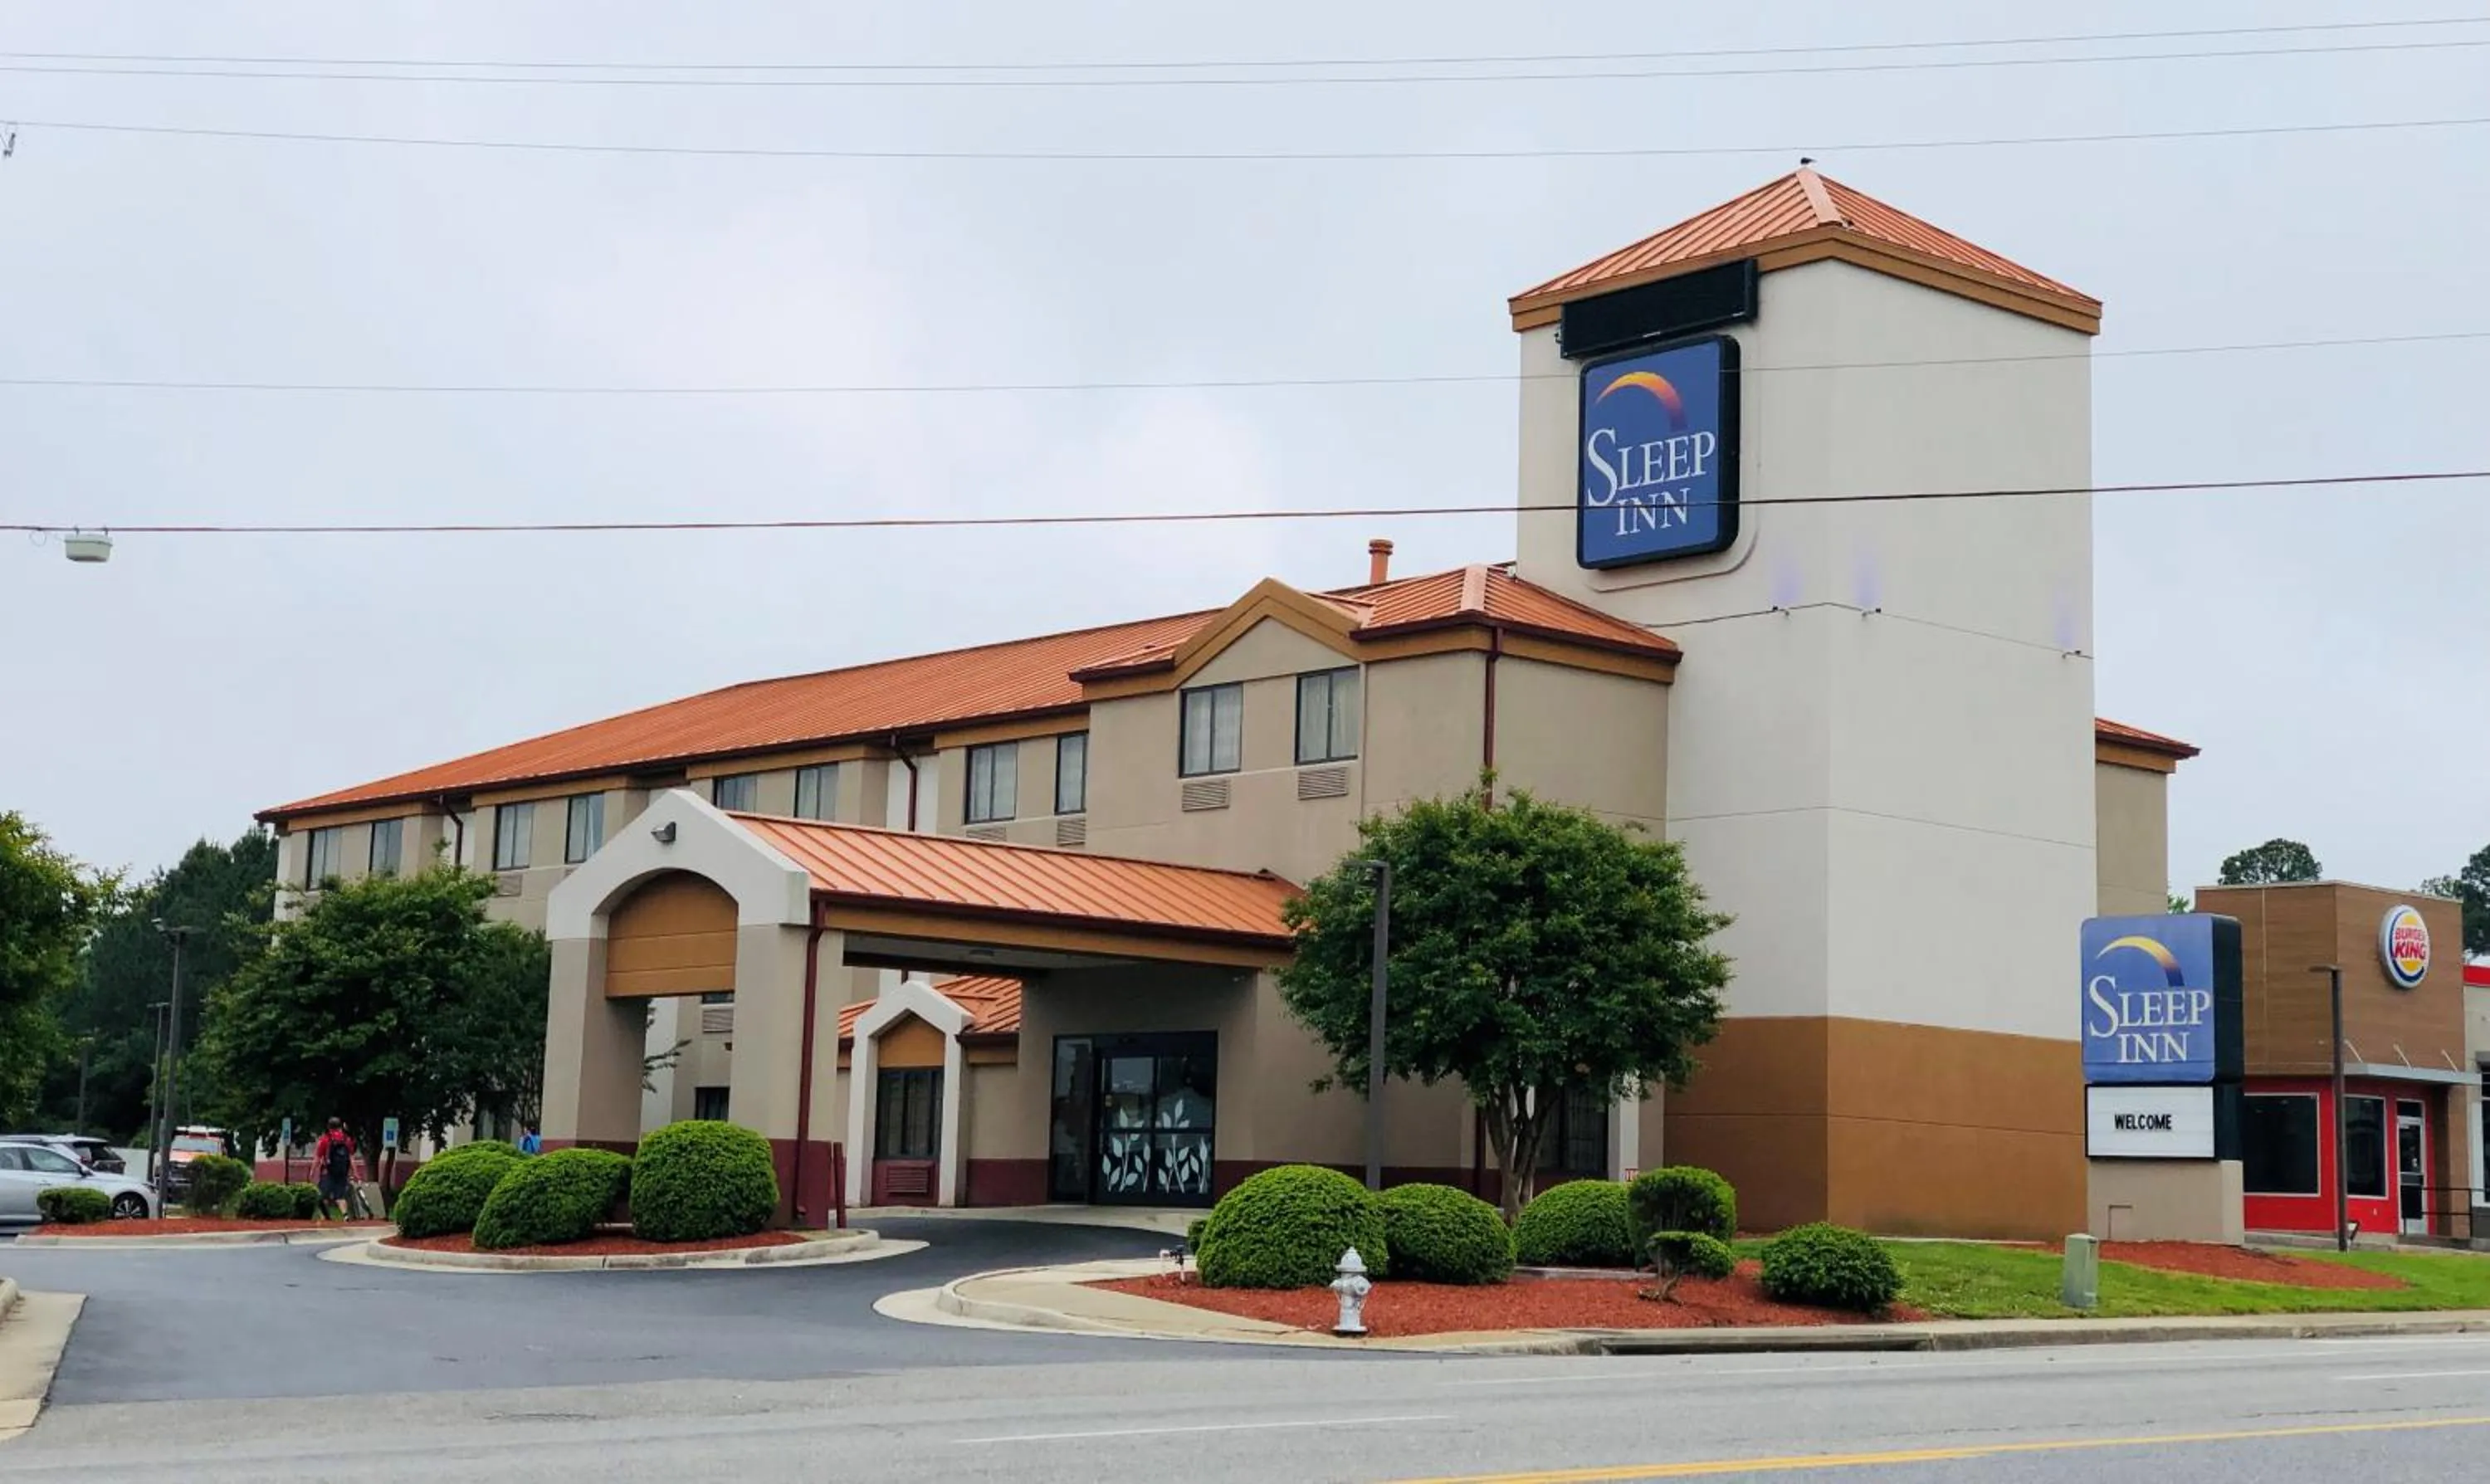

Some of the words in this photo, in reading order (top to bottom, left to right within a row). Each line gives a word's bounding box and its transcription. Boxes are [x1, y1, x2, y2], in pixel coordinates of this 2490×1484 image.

[1586, 427, 1716, 506] SLEEP
[1614, 487, 1690, 536] INN
[2395, 940, 2426, 959] KING
[2088, 974, 2211, 1037] SLEEP
[2117, 1032, 2190, 1063] INN
[2114, 1113, 2172, 1130] WELCOME
